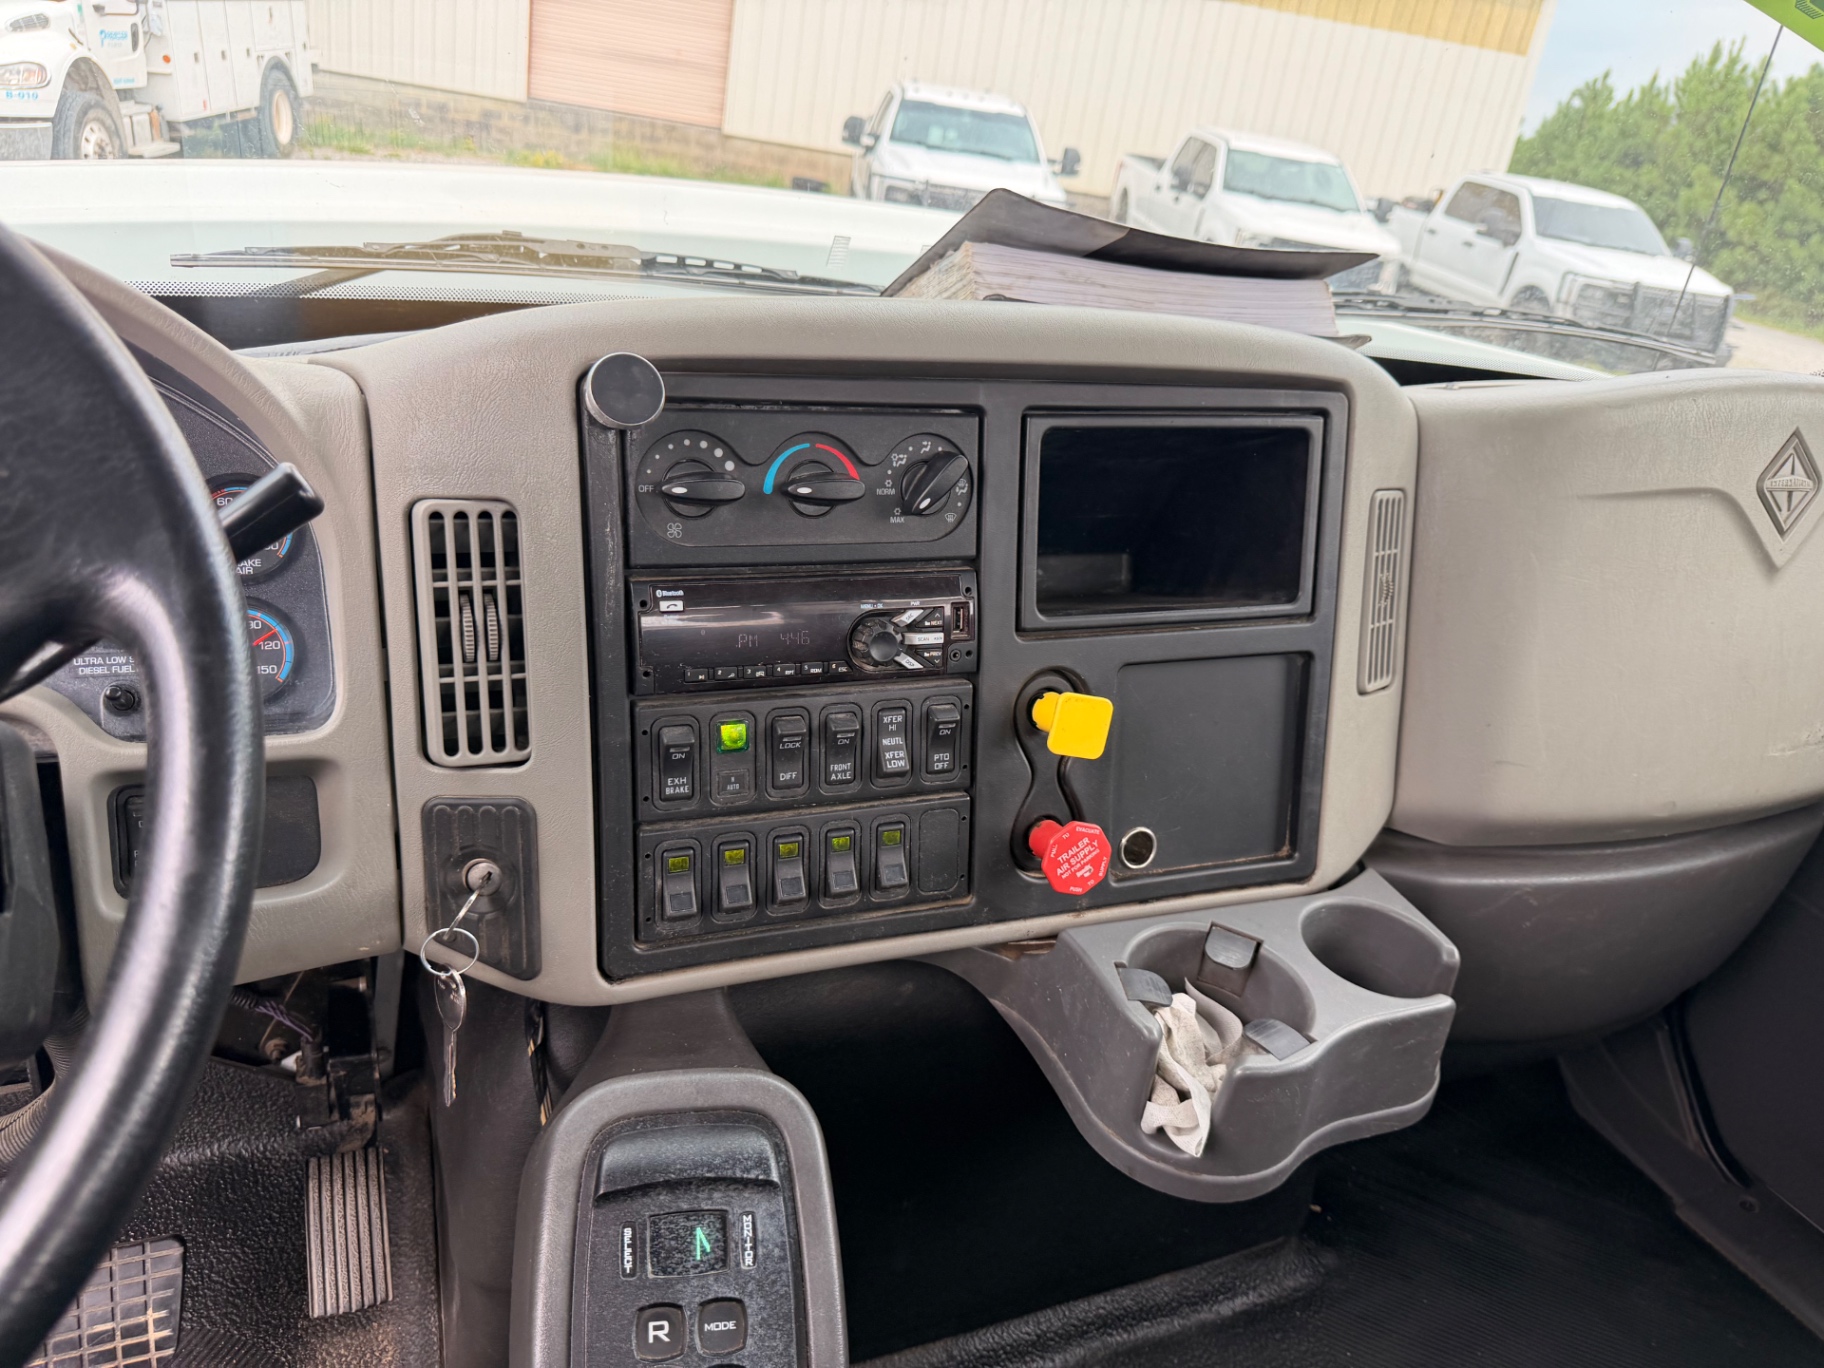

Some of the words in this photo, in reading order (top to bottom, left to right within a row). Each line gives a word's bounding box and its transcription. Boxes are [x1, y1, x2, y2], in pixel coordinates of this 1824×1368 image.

[638, 484, 655, 493] OFF
[876, 487, 896, 496] NORM
[889, 516, 906, 524] MAX
[238, 559, 262, 567] AKE
[236, 566, 254, 575] AIR
[780, 630, 810, 645] 446
[259, 640, 281, 650] 120
[73, 656, 104, 666] ULTRA
[106, 656, 127, 664] LOW
[79, 666, 111, 675] DIESEL
[112, 665, 135, 674] FUEL
[256, 664, 278, 675] 150
[882, 714, 903, 724] XFER
[888, 723, 897, 732] HI
[939, 728, 952, 736] ON
[779, 741, 802, 750] LOCK
[882, 736, 904, 746] NEUTL
[671, 752, 686, 760] ON
[884, 750, 905, 760] XFER
[933, 752, 950, 762] PTO
[830, 762, 852, 772] FRONT
[886, 759, 906, 769] LOW
[934, 761, 950, 771] OFF
[667, 776, 687, 786] EXH
[779, 771, 798, 781] DIFF
[830, 771, 852, 781] AXLE
[665, 785, 690, 795] BRAKE
[726, 783, 740, 791] AUTO
[1050, 844, 1058, 858] PULL
[1061, 832, 1070, 840] TO
[1075, 826, 1100, 835] EVACUATE
[1056, 836, 1091, 864] TRAILER
[1056, 862, 1071, 877] AIR
[1069, 839, 1099, 866] SUPPLY
[1061, 869, 1072, 880] NOT
[1080, 848, 1100, 866] PARKING
[1098, 856, 1108, 877] SUPPLY
[742, 1214, 754, 1267] MONITOR
[623, 1227, 633, 1274] SELECT
[704, 1320, 737, 1332] MODE
[648, 1320, 671, 1344] R
